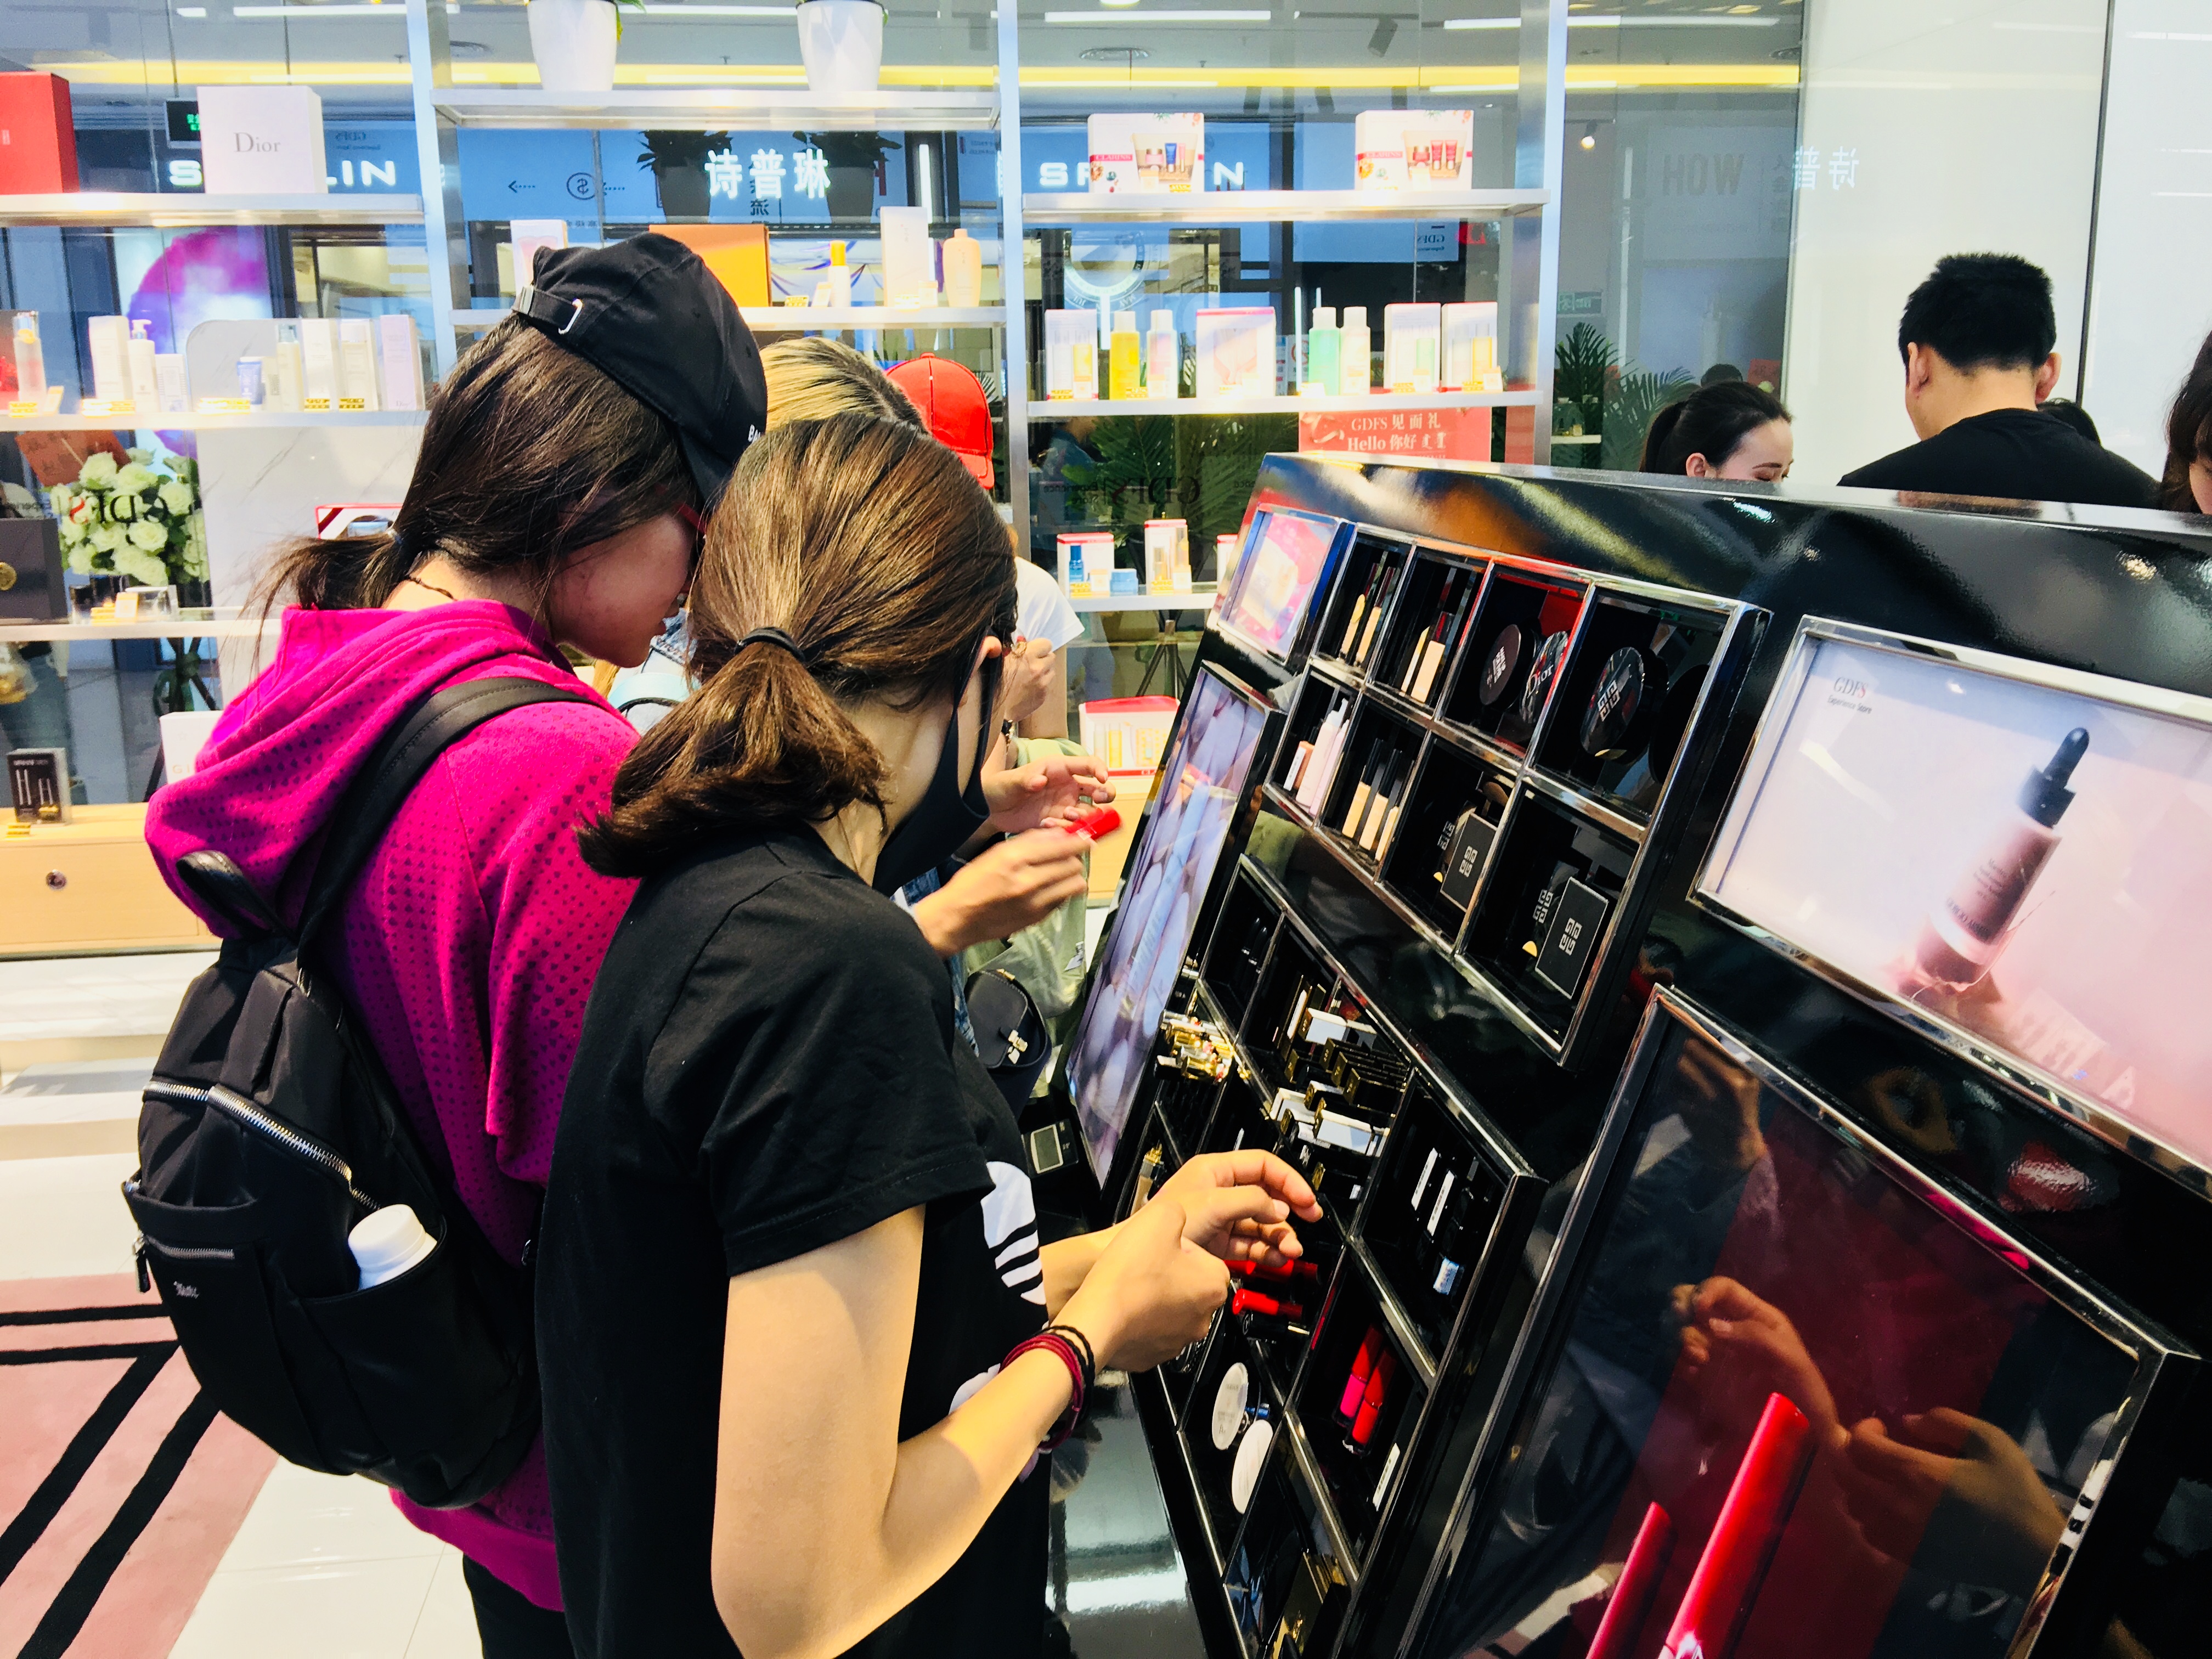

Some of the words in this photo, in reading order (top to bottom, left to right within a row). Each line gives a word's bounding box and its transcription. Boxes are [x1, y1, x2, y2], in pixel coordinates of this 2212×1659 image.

[233, 132, 281, 153] Dior
[704, 148, 831, 199] 诗普琳
[1351, 416, 1387, 431] GDFS
[1391, 412, 1441, 430] 见面礼
[1347, 435, 1386, 452] Hello
[1389, 433, 1417, 451] 你好
[1833, 676, 1869, 699] GDFS
